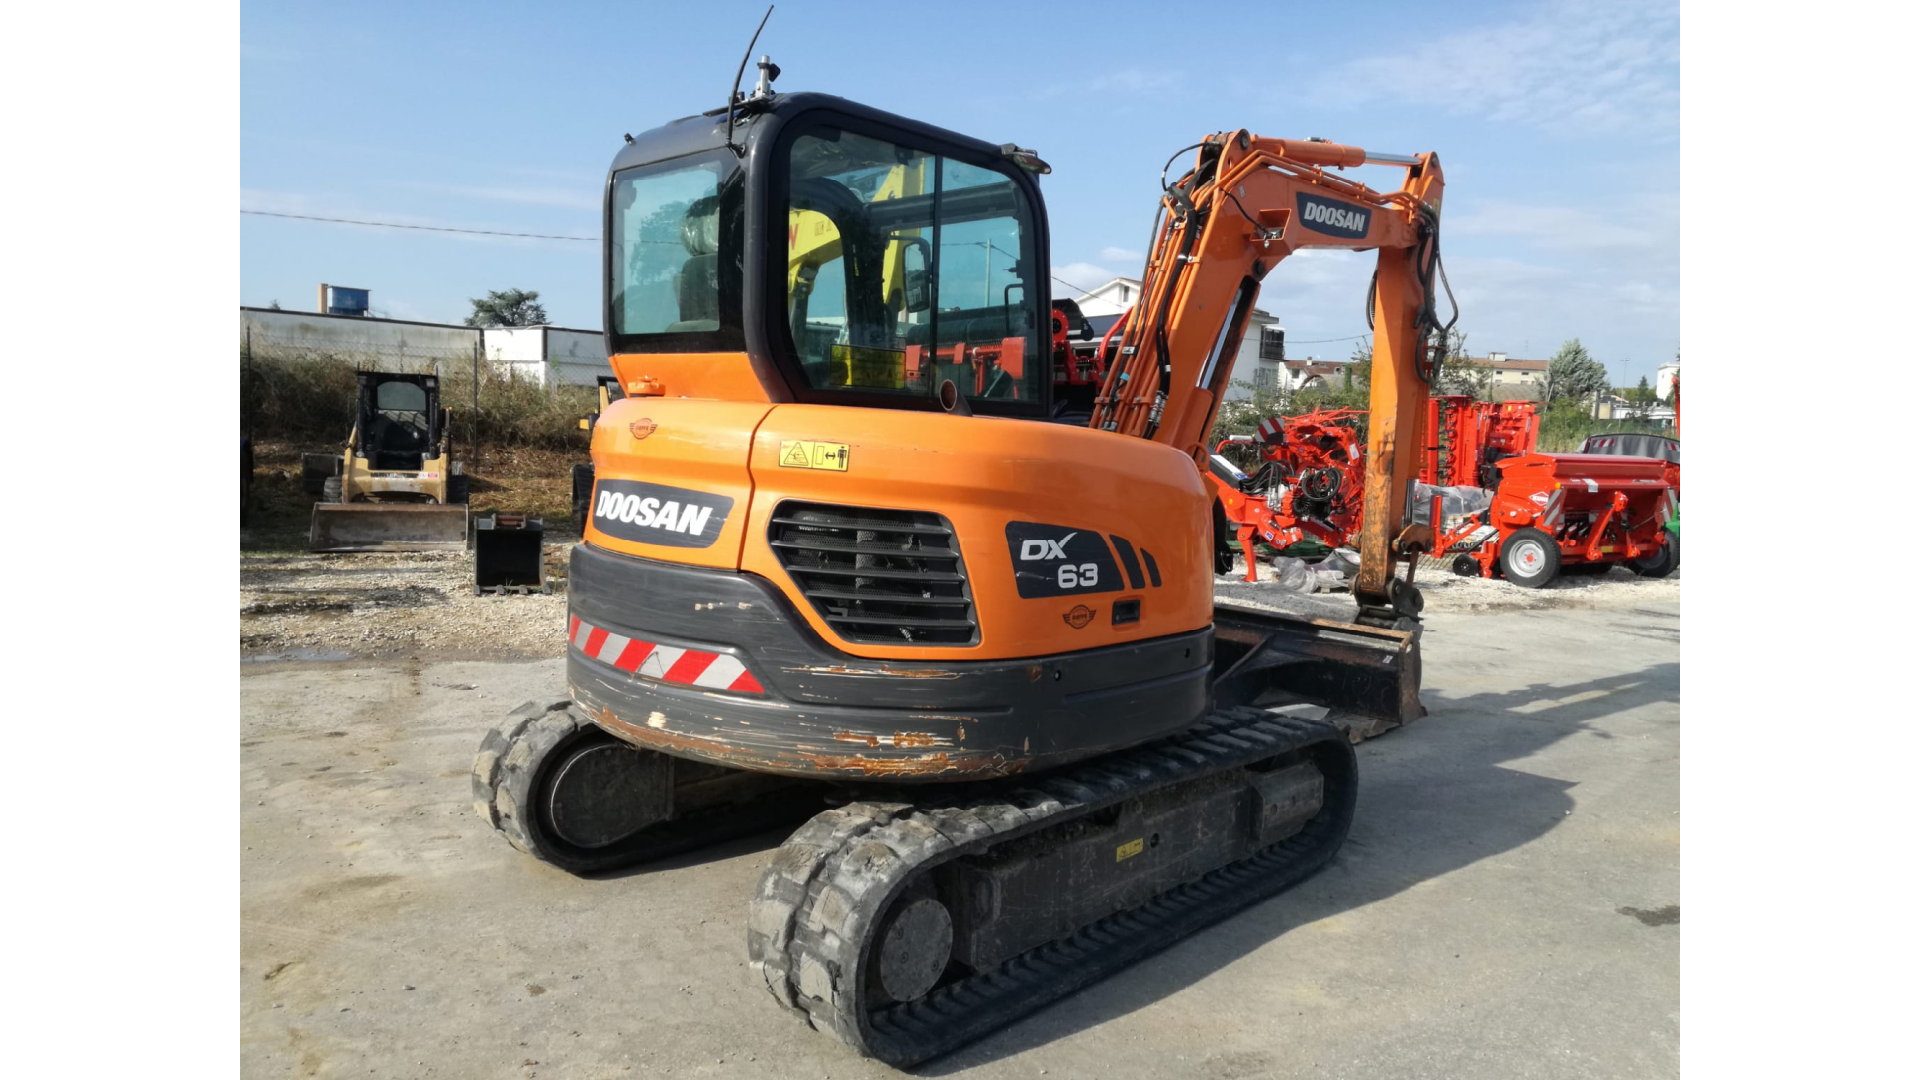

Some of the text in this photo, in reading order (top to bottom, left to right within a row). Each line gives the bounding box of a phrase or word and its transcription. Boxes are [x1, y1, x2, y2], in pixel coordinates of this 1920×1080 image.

[1303, 202, 1366, 232] DOOSAN
[595, 490, 713, 536] DOOSAN
[1020, 532, 1079, 561] DX
[1057, 563, 1099, 589] 63
